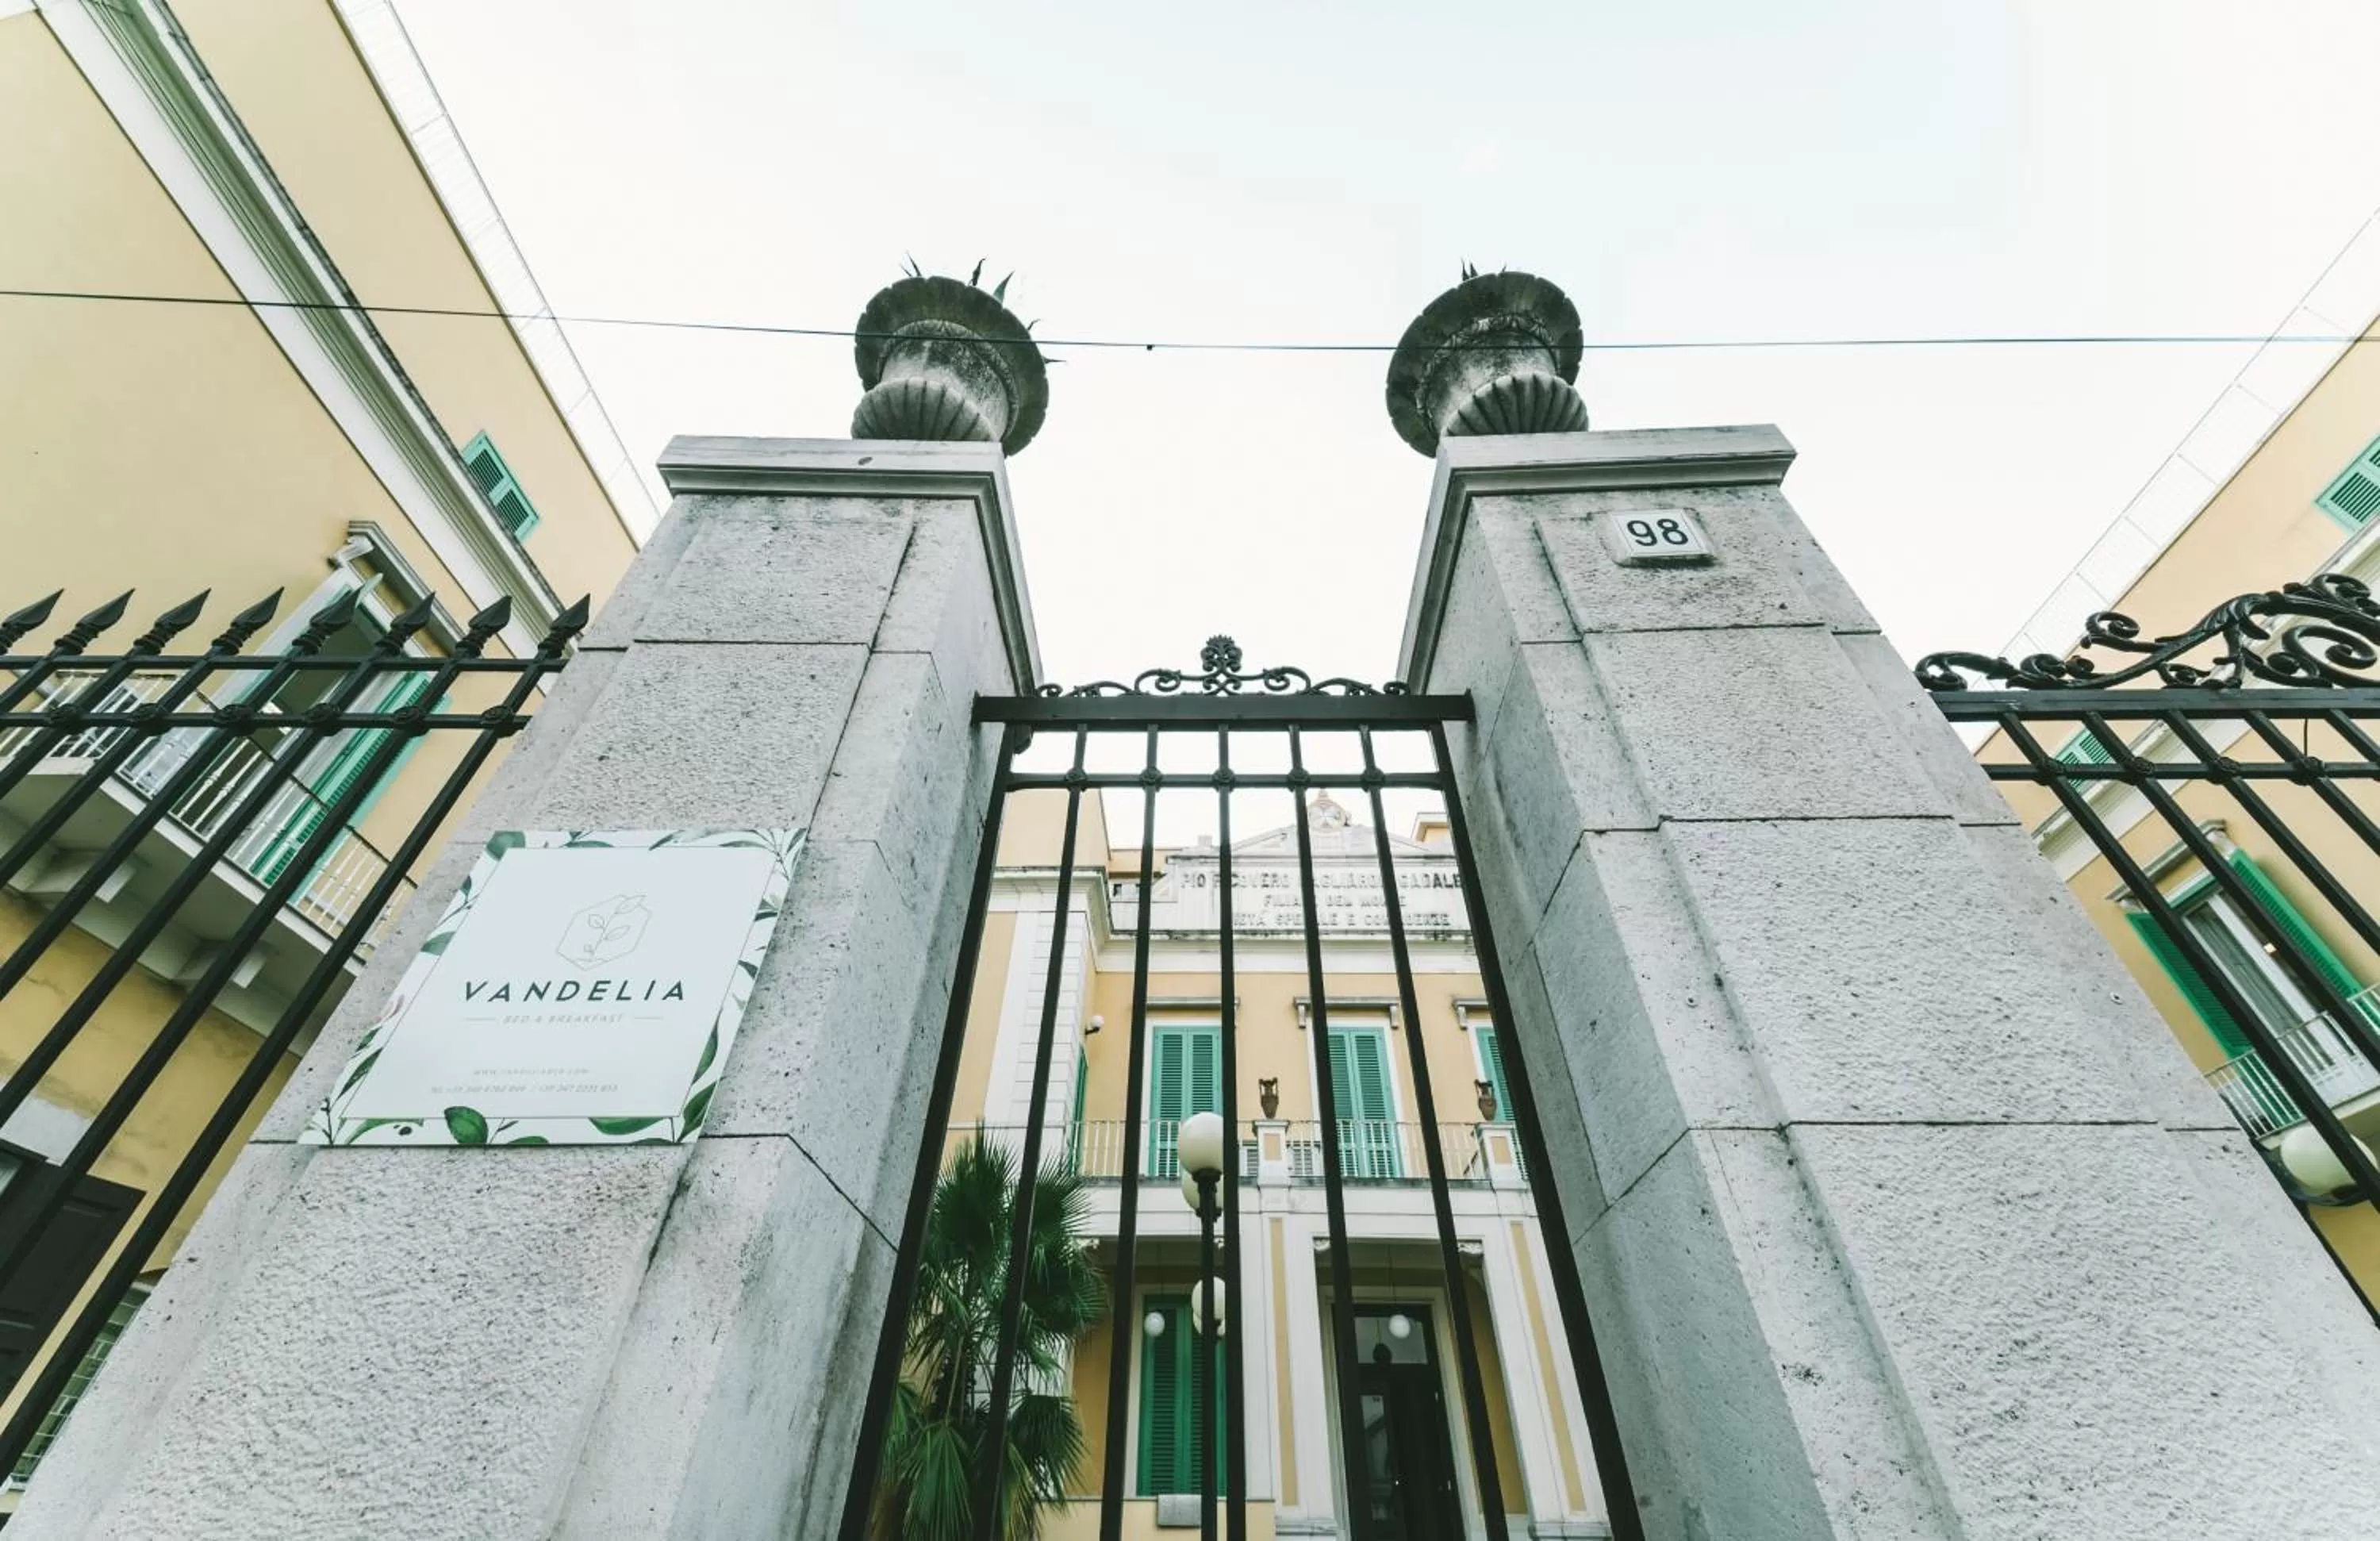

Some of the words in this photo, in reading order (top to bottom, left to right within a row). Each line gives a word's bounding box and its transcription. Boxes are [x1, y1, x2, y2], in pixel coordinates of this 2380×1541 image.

[1626, 518, 1688, 547] 98
[1180, 873, 1206, 889] PIO
[1213, 873, 1289, 889] RCOVERO
[1360, 895, 1406, 907] MONE
[1277, 914, 1338, 926] SPELE
[1365, 914, 1451, 926] CONDENZE
[465, 980, 684, 1002] VANDELIA
[548, 1013, 624, 1024] BREAKFAST
